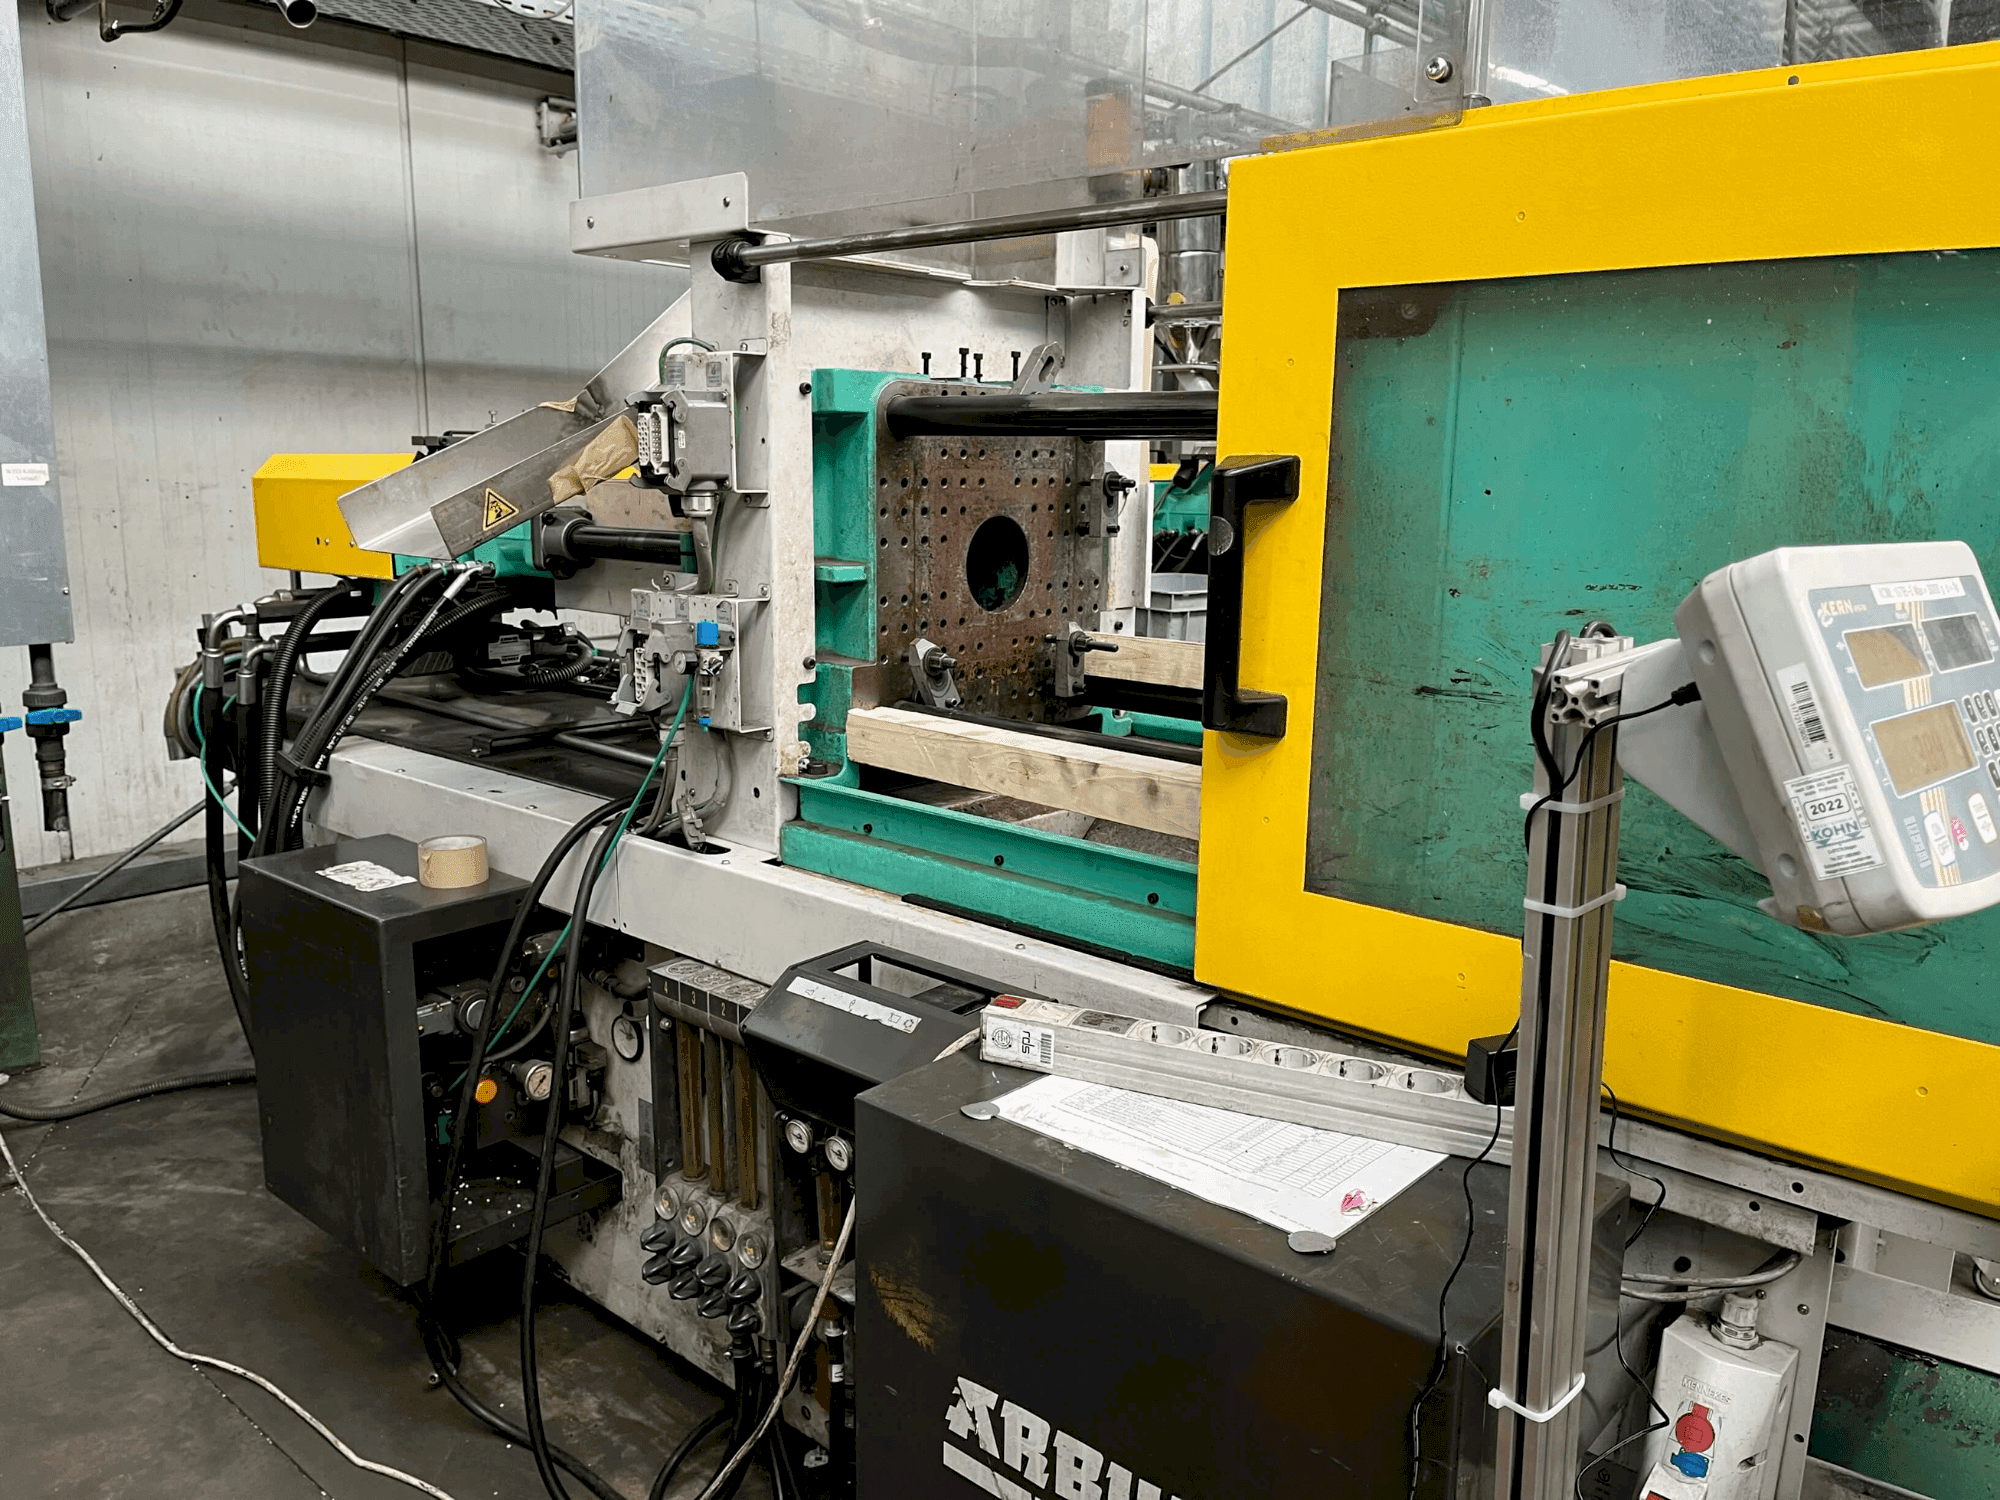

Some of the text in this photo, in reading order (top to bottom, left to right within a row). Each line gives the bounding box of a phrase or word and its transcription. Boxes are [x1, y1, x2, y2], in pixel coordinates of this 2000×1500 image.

[1821, 599, 1854, 616] KERN
[1810, 798, 1844, 815] 2022
[1811, 820, 1859, 841] KOHN
[691, 990, 697, 1005] 3
[721, 1002, 726, 1016] 2
[1021, 1030, 1036, 1055] rds
[1682, 1377, 1731, 1404] MENNEKES
